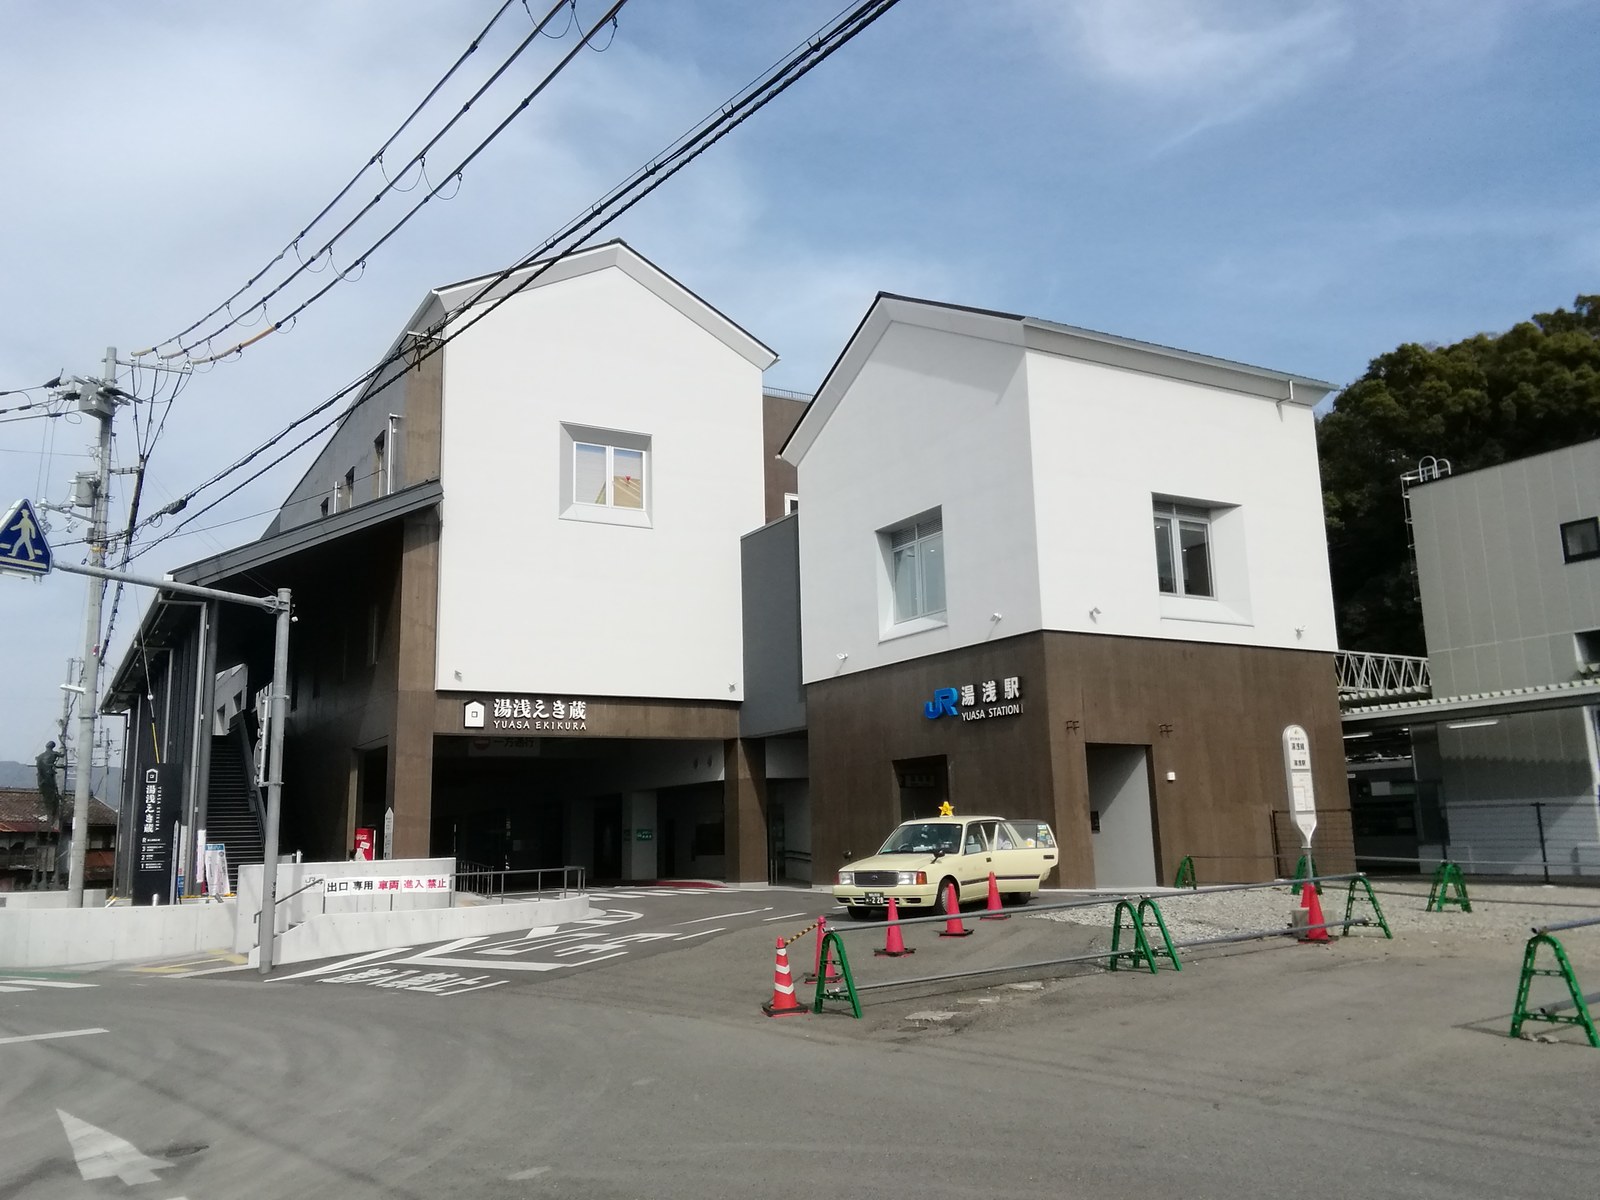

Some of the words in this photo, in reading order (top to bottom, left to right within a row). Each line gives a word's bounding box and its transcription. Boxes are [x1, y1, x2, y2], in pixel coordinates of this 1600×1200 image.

[925, 687, 958, 719] JR
[961, 676, 1020, 707] 湯浅駅
[493, 698, 587, 720] 湯浅えき蔵
[961, 709, 986, 721] YUASA
[988, 703, 1020, 718] STATION
[493, 720, 531, 729] YUASA
[535, 721, 587, 730] EKIKURA
[143, 785, 156, 833] 湯浅えき蔵
